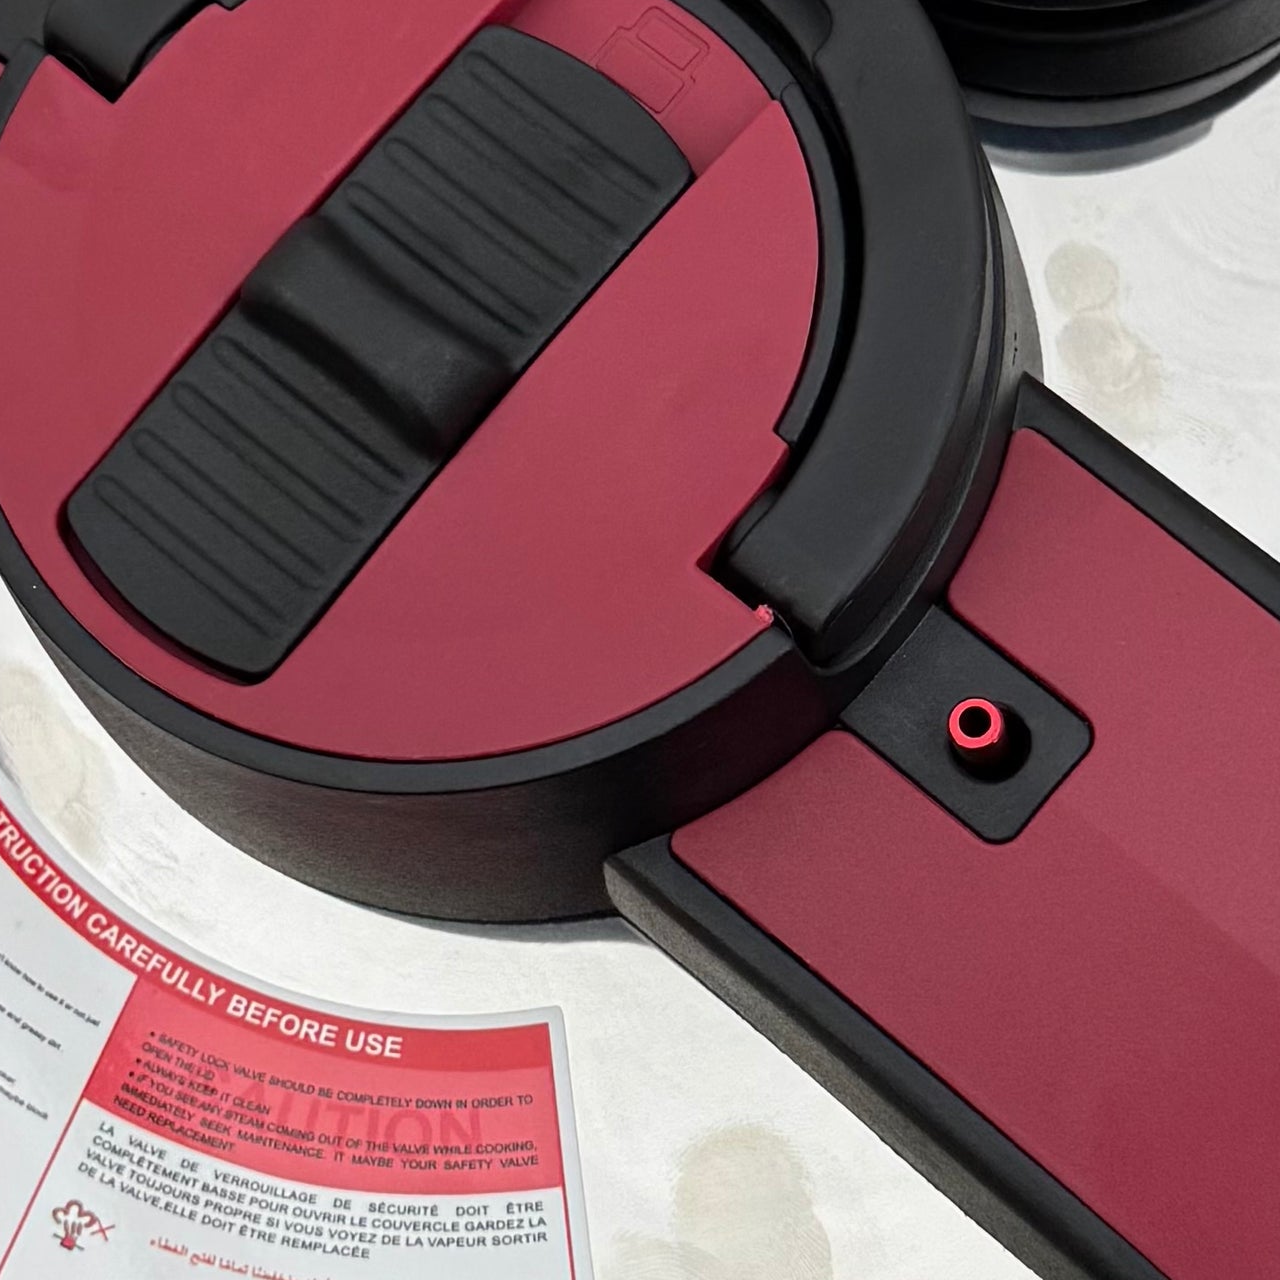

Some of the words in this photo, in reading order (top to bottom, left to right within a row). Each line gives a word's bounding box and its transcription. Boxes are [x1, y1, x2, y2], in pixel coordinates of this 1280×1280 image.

[86, 911, 226, 1010] CAREFULLY
[225, 995, 338, 1054] BEFORE
[345, 1029, 404, 1058] USE
[142, 1042, 172, 1062] OPEN
[175, 1056, 196, 1073] THE
[197, 1067, 215, 1080] LID
[143, 1060, 184, 1085] ALWAYS
[188, 1079, 219, 1096] KEEP
[220, 1092, 230, 1103] IT
[233, 1096, 271, 1115] CLEAN
[159, 1034, 198, 1057] SAFETY
[201, 1054, 229, 1071] LOCK
[234, 1063, 266, 1083] VALVE
[269, 1075, 315, 1094] SHOULD
[318, 1087, 332, 1098] BE
[337, 1090, 412, 1108] COMPLETELY
[415, 1098, 451, 1109] DOWN
[456, 1099, 467, 1109] IN
[471, 1096, 513, 1108] ORDER
[518, 1094, 533, 1104] TO
[113, 1095, 146, 1118] NEED
[121, 1082, 195, 1121] IMMEDIATELY
[200, 1117, 233, 1136] SEEK
[334, 1152, 345, 1162] IT
[352, 1155, 393, 1168] MAYBE
[401, 1160, 437, 1170] YOUR
[444, 1159, 492, 1170] SAFETY
[500, 1155, 538, 1167] VALVE
[136, 1073, 148, 1084] IF
[150, 1078, 173, 1096] YOU
[175, 1090, 197, 1107] SEE
[197, 1098, 222, 1115] ANY
[224, 1109, 266, 1130] STEAM
[266, 1123, 315, 1143] COMING
[317, 1134, 342, 1147] OUT
[345, 1138, 362, 1149] OF
[366, 1141, 388, 1153] THE
[393, 1144, 429, 1155] VALVE
[433, 1144, 472, 1155] WHILE
[476, 1141, 537, 1154] COOKING,
[85, 1148, 123, 1176] VALVE
[129, 1169, 200, 1206] TOUJOURS
[204, 1199, 262, 1224] PROPRE
[266, 1215, 279, 1228] SI
[283, 1218, 323, 1237] VOUS
[328, 1229, 376, 1243] VOYEZ
[382, 1234, 401, 1246] DE
[406, 1236, 424, 1247] LA
[428, 1236, 486, 1247] VAPEUR
[491, 1232, 548, 1246] SORTIR
[100, 1121, 115, 1137] LA
[128, 1135, 167, 1160] VALVE
[180, 1159, 199, 1172] DE
[214, 1170, 318, 1205] VERROUILLAGE
[333, 1198, 351, 1210] DE
[368, 1201, 439, 1216] SÉCURITÉ
[456, 1205, 489, 1216] DOIT
[506, 1200, 544, 1214] ÊTRE
[201, 1182, 245, 1204] BASSE
[249, 1196, 289, 1218] POUR
[292, 1207, 346, 1227] OUVRIR
[350, 1215, 367, 1227] LE
[372, 1219, 459, 1232] COUVERCLE
[464, 1220, 523, 1232] GARDEZ
[528, 1216, 547, 1228] LA
[78, 1162, 97, 1178] DE
[99, 1171, 116, 1188] LA
[201, 1214, 234, 1233] DOIT
[239, 1225, 276, 1244] ÊTRE
[280, 1237, 370, 1260] REMPLACÉE
